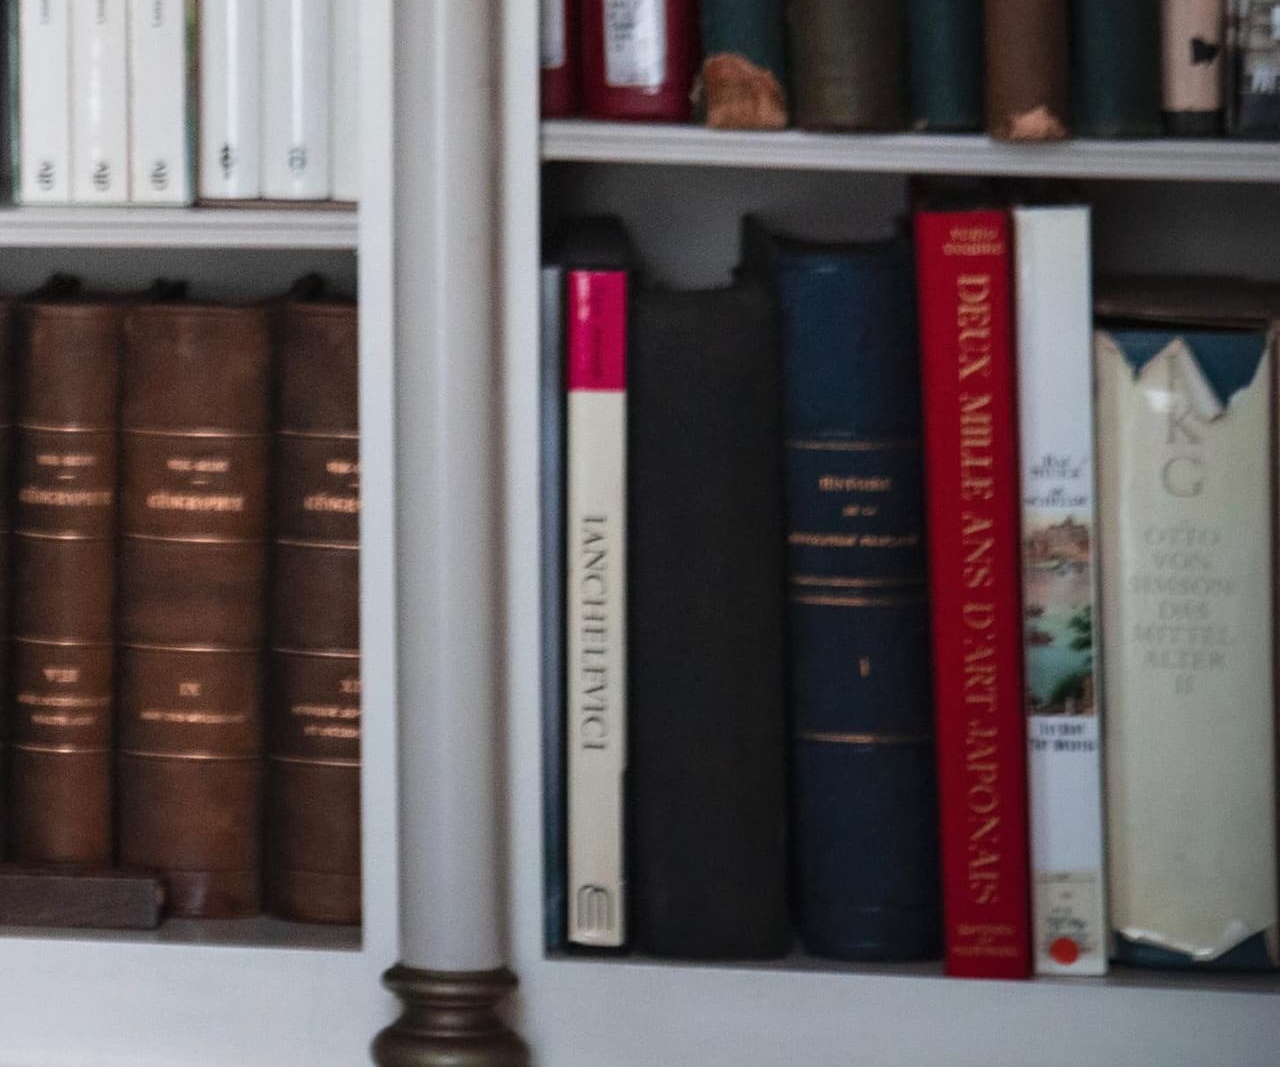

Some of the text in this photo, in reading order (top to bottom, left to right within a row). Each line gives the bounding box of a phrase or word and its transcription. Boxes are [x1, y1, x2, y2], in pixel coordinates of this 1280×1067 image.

[956, 274, 992, 380] DEUX
[959, 392, 995, 501] MILLE
[961, 511, 996, 588] ANS
[963, 603, 997, 712] D'ART
[966, 718, 1001, 905] JAPONAIS
